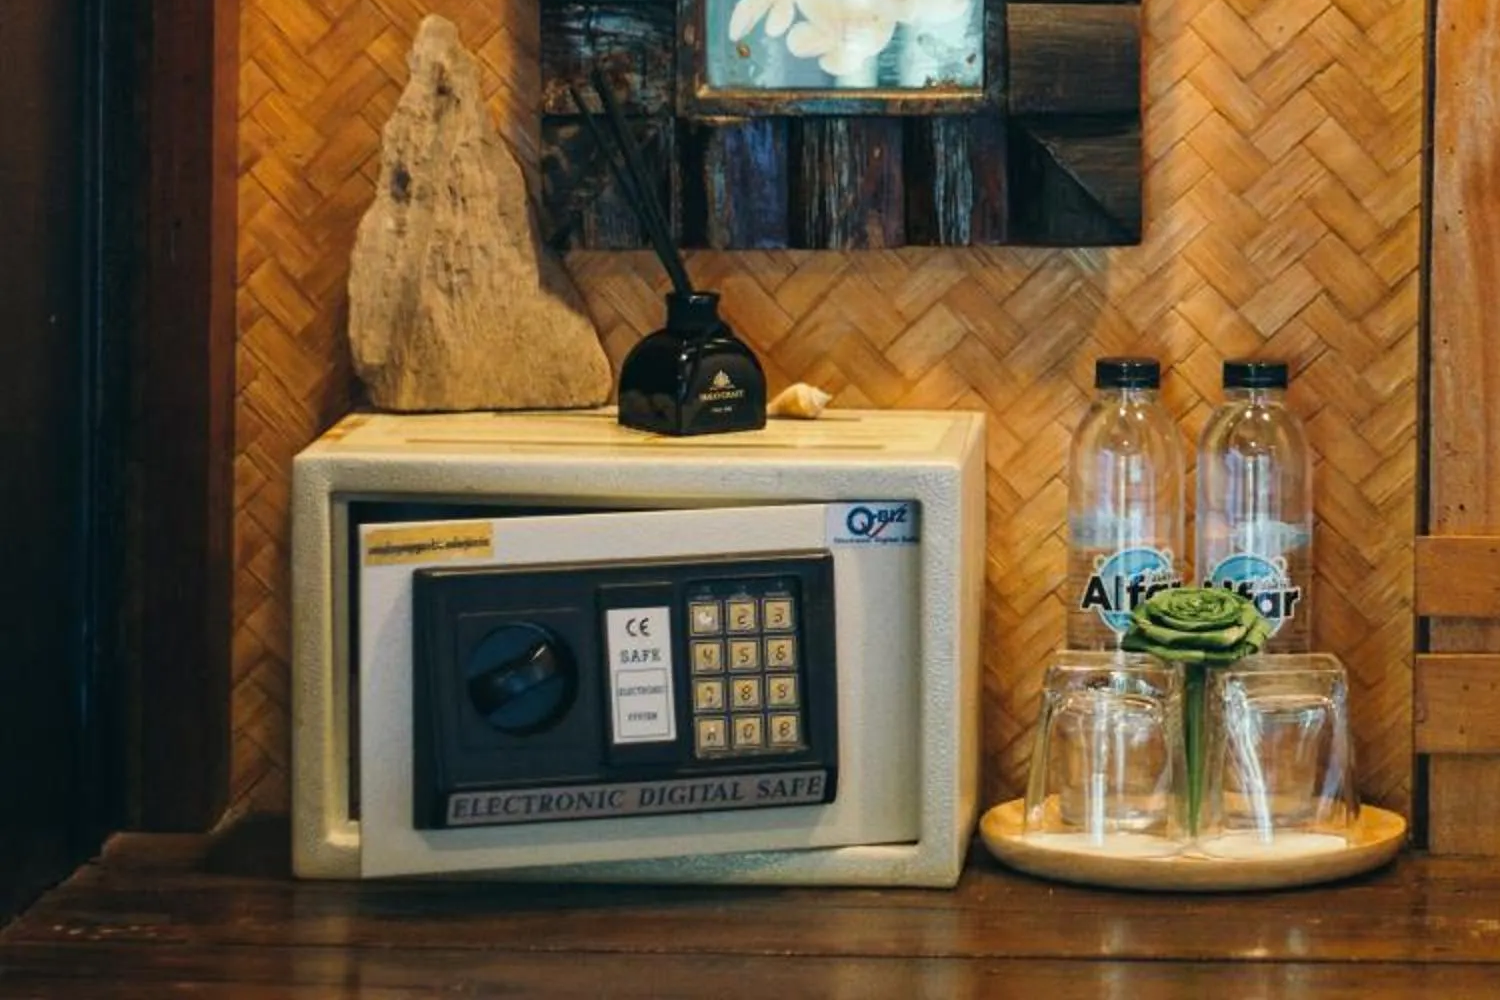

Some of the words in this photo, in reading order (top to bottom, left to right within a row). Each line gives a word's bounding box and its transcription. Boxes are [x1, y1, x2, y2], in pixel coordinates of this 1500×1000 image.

[620, 647, 662, 664] SAFE
[453, 789, 625, 818] ELECTRONIC
[638, 781, 745, 807] DIGITAL
[756, 775, 821, 799] SAFE
